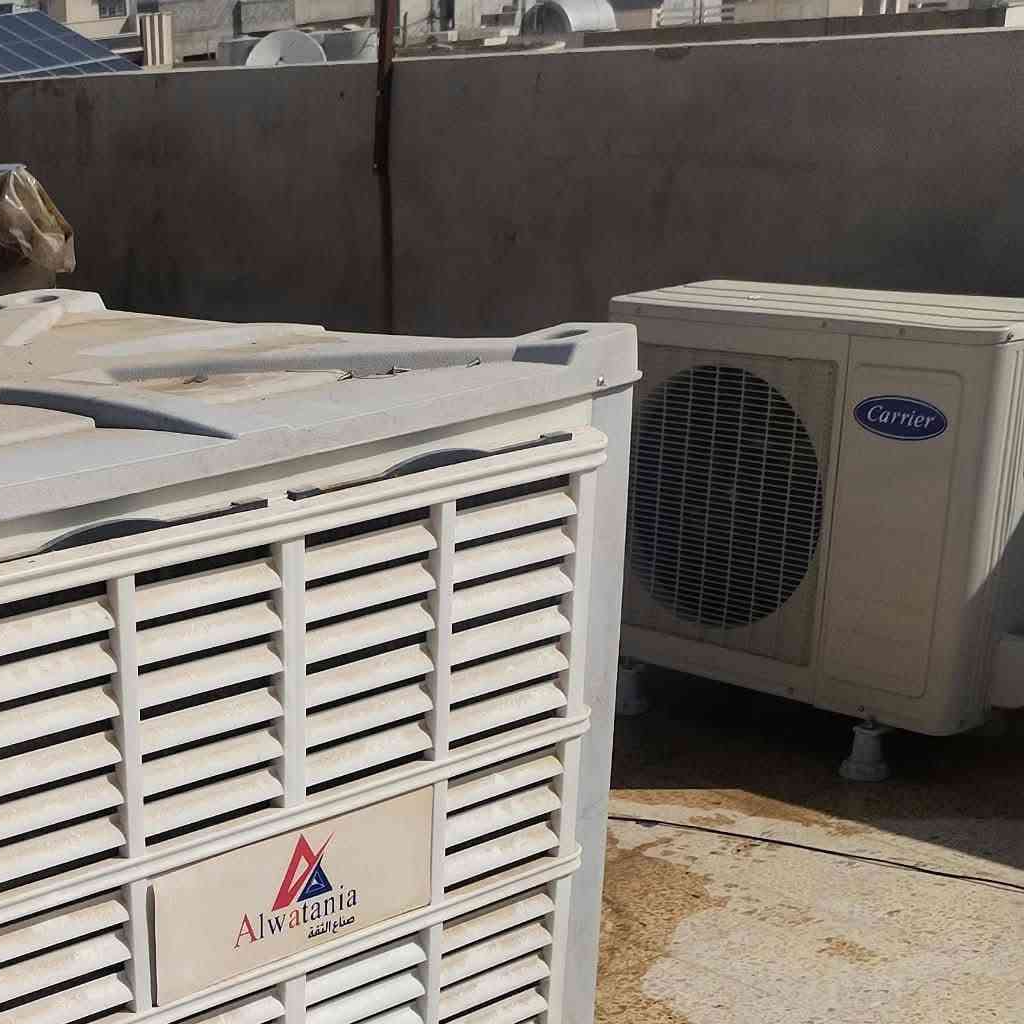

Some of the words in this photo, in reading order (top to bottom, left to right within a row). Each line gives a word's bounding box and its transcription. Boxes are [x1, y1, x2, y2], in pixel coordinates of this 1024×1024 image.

[866, 404, 936, 429] Carrier
[233, 884, 358, 949] Alwatania
[332, 915, 355, 934] صناع
